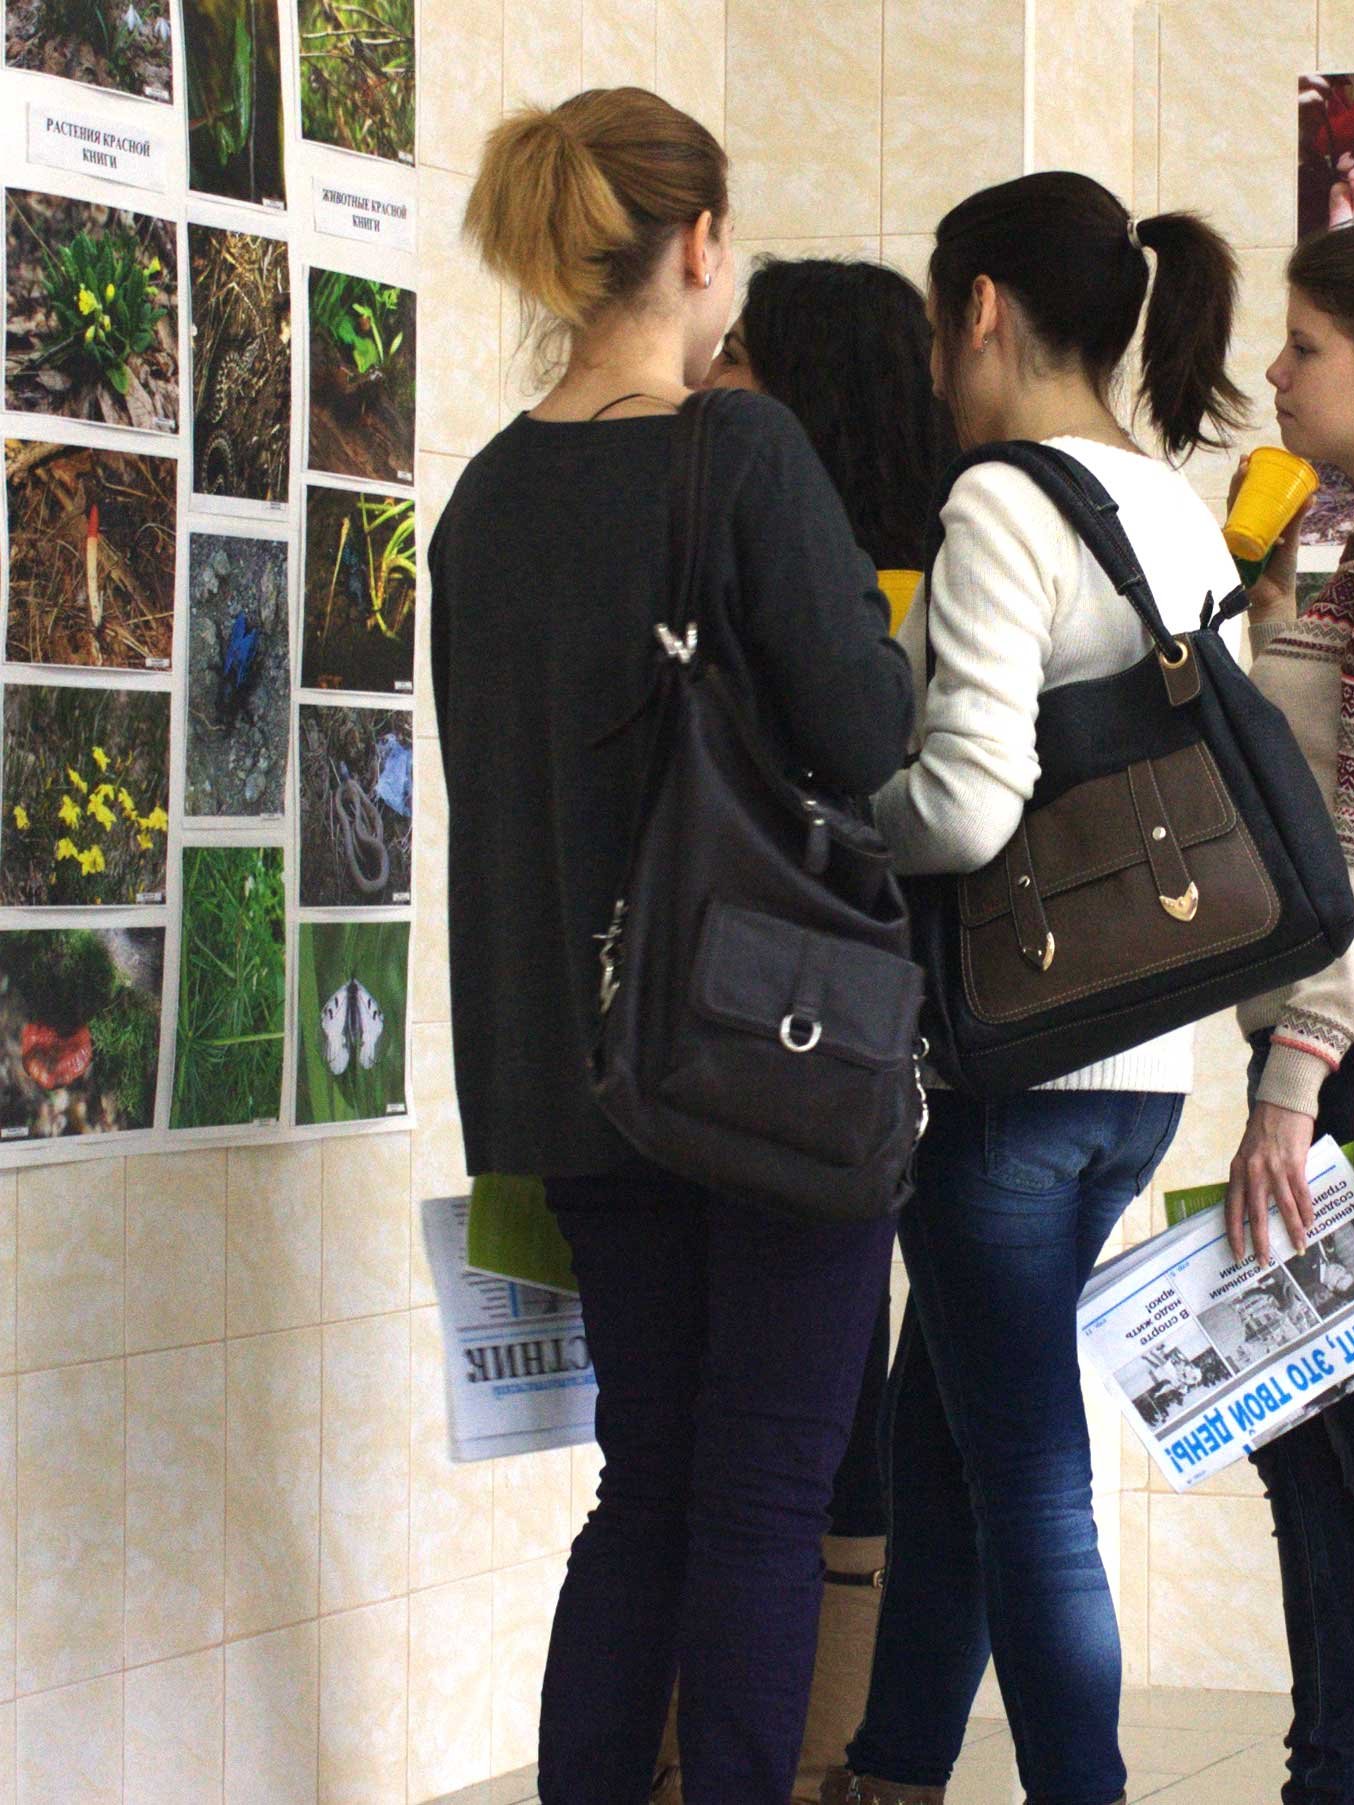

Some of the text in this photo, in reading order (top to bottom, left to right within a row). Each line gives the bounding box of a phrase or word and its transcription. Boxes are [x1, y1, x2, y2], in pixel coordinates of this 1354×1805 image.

[46, 117, 151, 158] РАСТЕНИЯ КРАСНОЙ
[82, 148, 118, 169] КНИГИ
[322, 188, 407, 219] ЖИВОТНЫЕ КРАСНОЙ
[352, 214, 380, 232] КНИГИ
[1209, 1257, 1276, 1300] Зездными
[1126, 1298, 1182, 1339] надо жить
[1145, 1288, 1175, 1313] ярко!
[1140, 1308, 1190, 1346] В спорте
[463, 1335, 590, 1383] СТНИК
[1287, 1349, 1335, 1391] ЭТО
[1228, 1377, 1293, 1435] ТВОЙ
[1164, 1408, 1235, 1473] ДЕНЬ!
